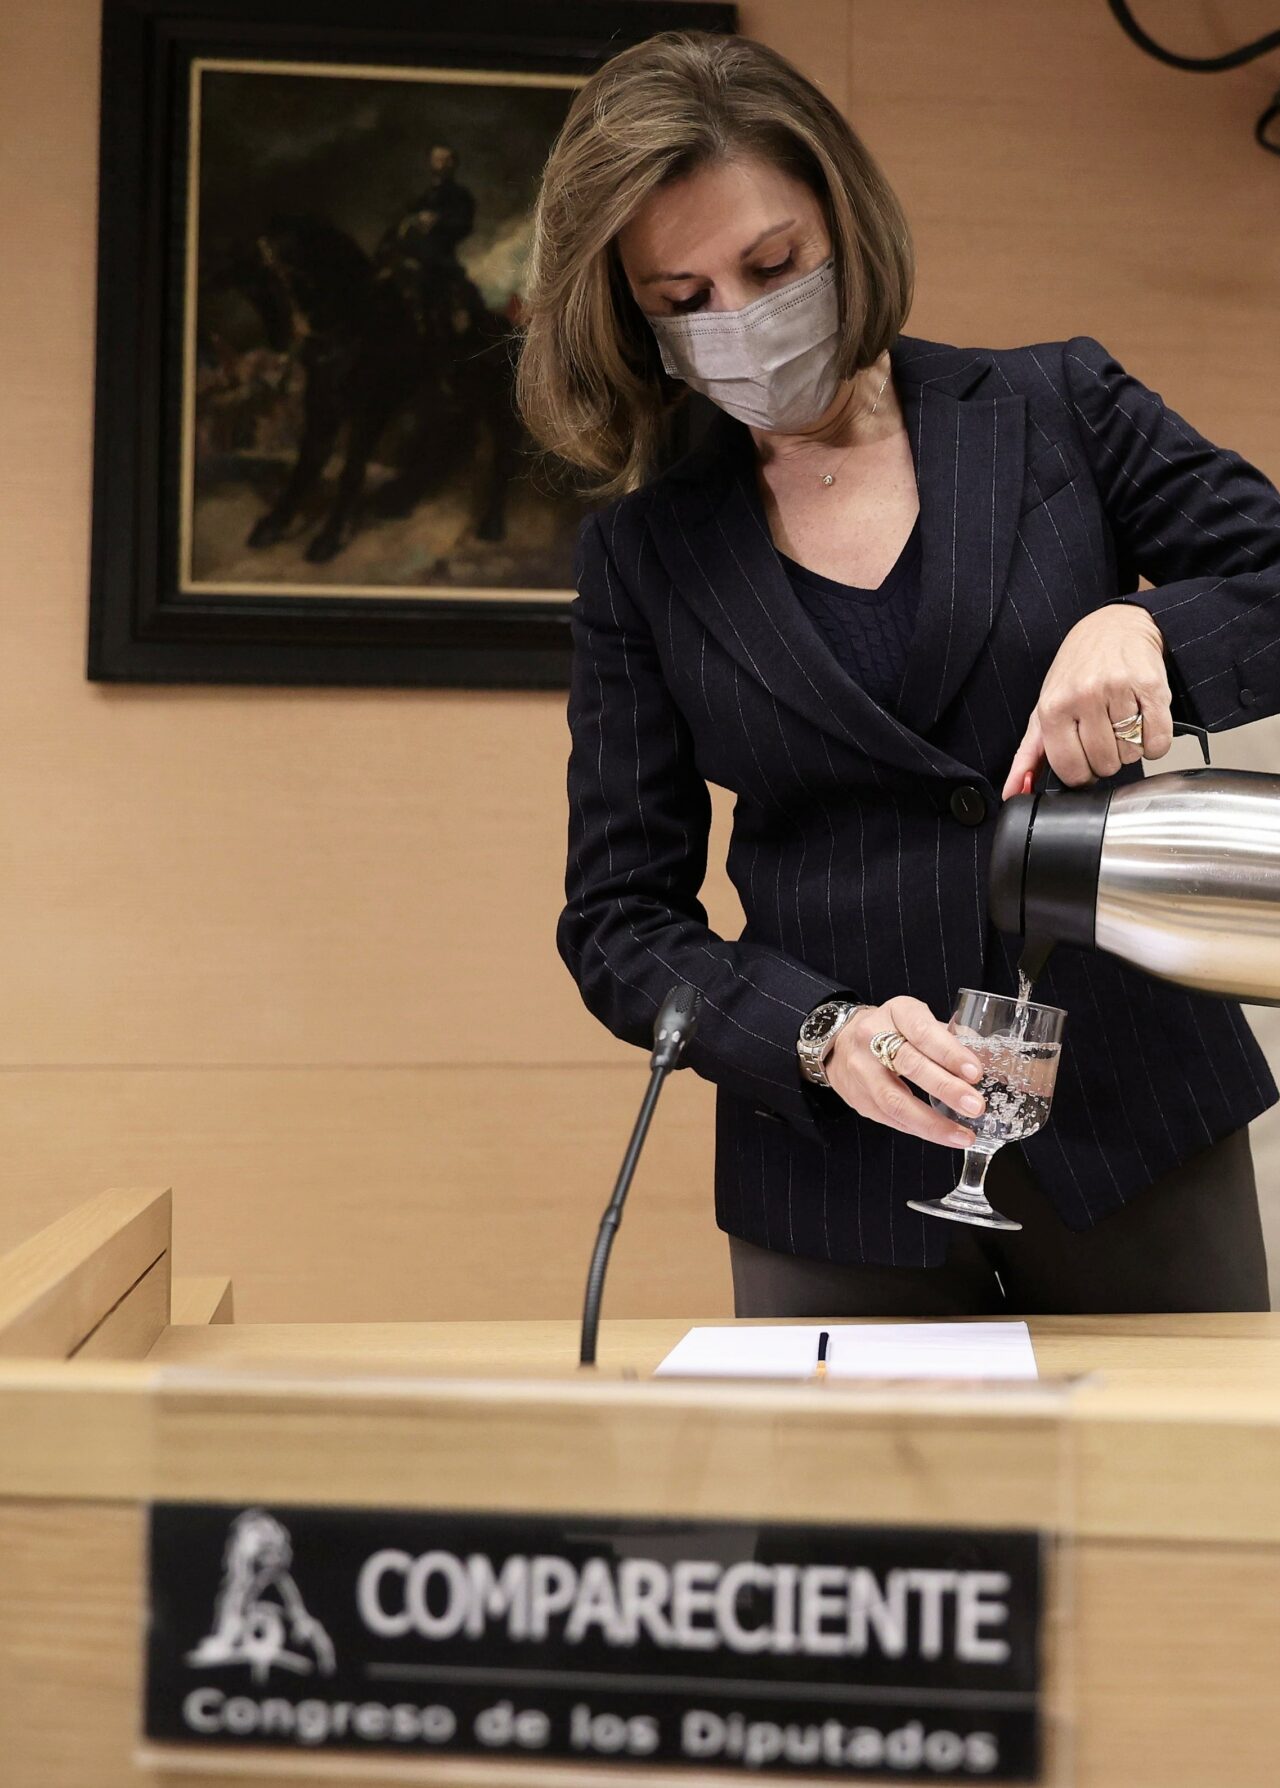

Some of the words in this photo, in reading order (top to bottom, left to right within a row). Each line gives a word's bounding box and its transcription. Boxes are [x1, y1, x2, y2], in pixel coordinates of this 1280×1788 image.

[356, 1549, 1010, 1663] COMPARECIENTE
[182, 1687, 456, 1744] Congreso
[474, 1702, 551, 1747] de
[571, 1702, 659, 1755] los
[681, 1709, 998, 1773] Diputados
